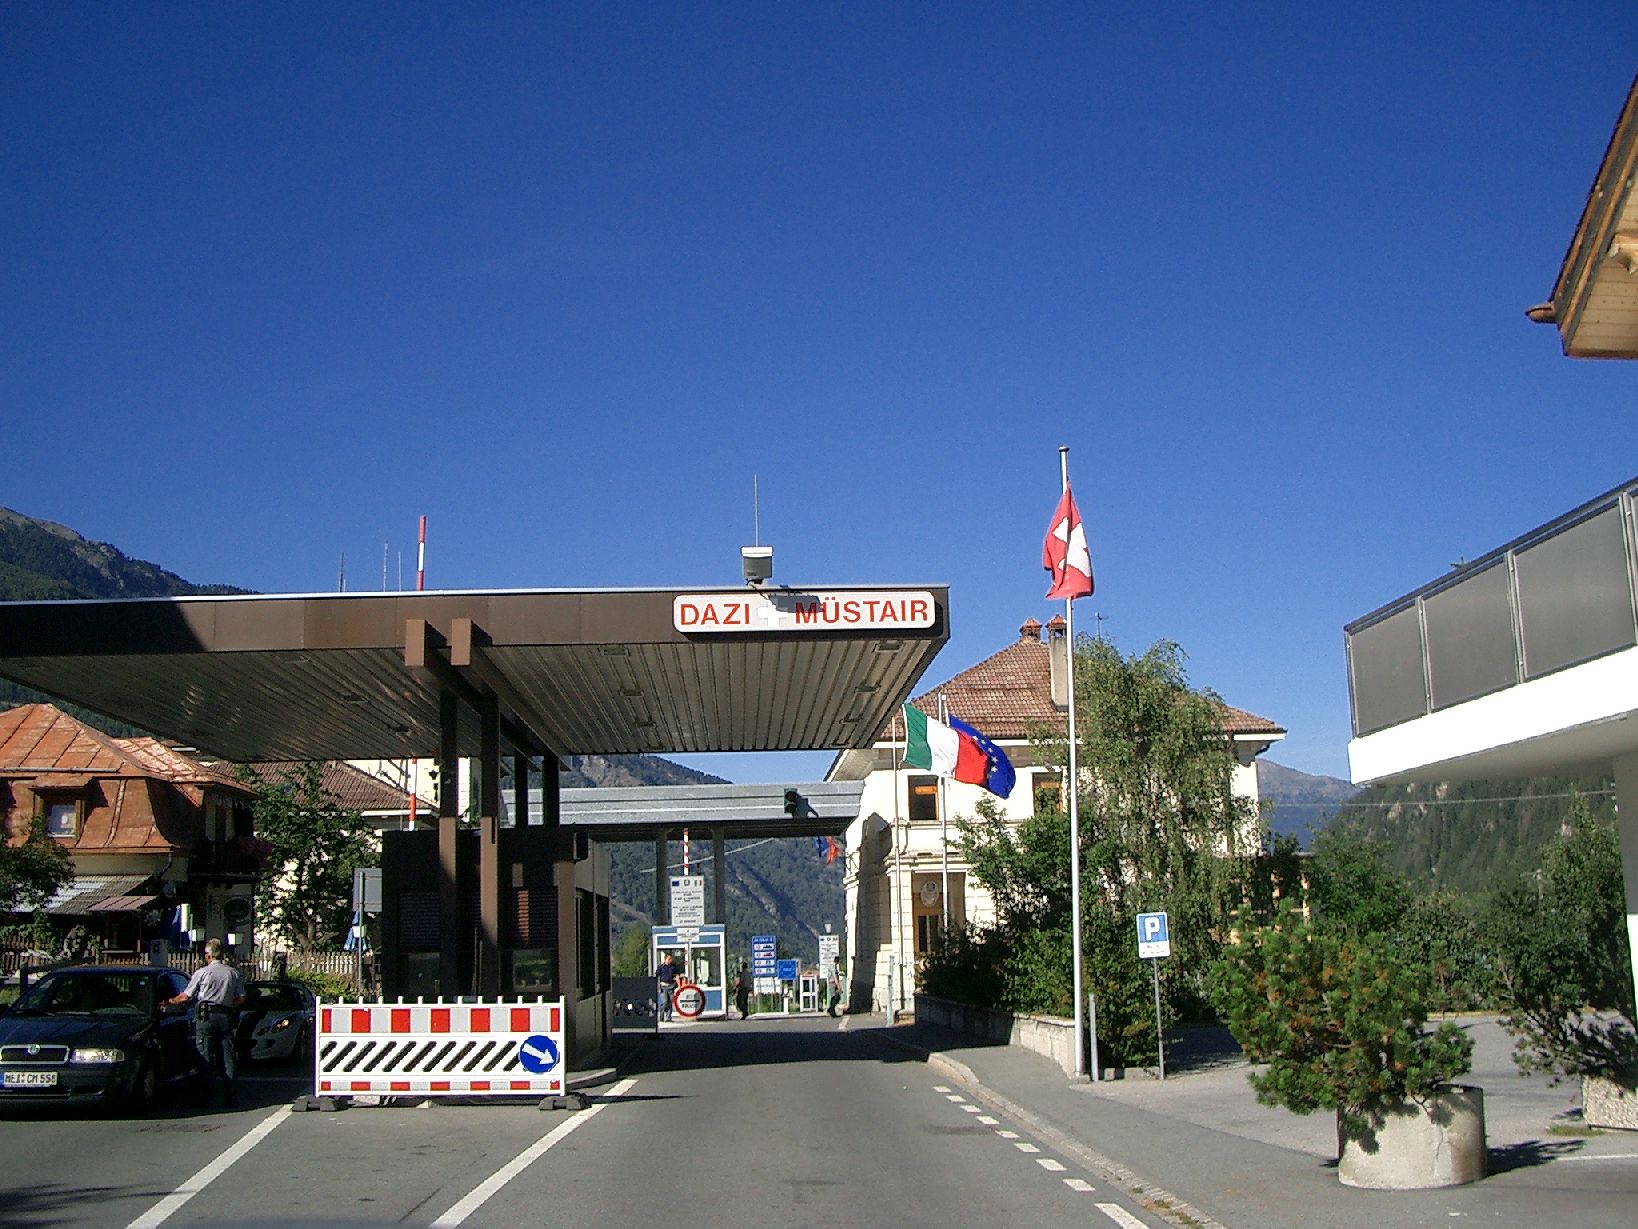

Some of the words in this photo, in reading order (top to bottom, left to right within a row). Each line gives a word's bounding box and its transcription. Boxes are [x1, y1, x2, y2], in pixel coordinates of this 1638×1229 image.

[680, 603, 750, 625] DAZI
[795, 597, 928, 624] MÜSTAIR
[1144, 916, 1160, 941] P
